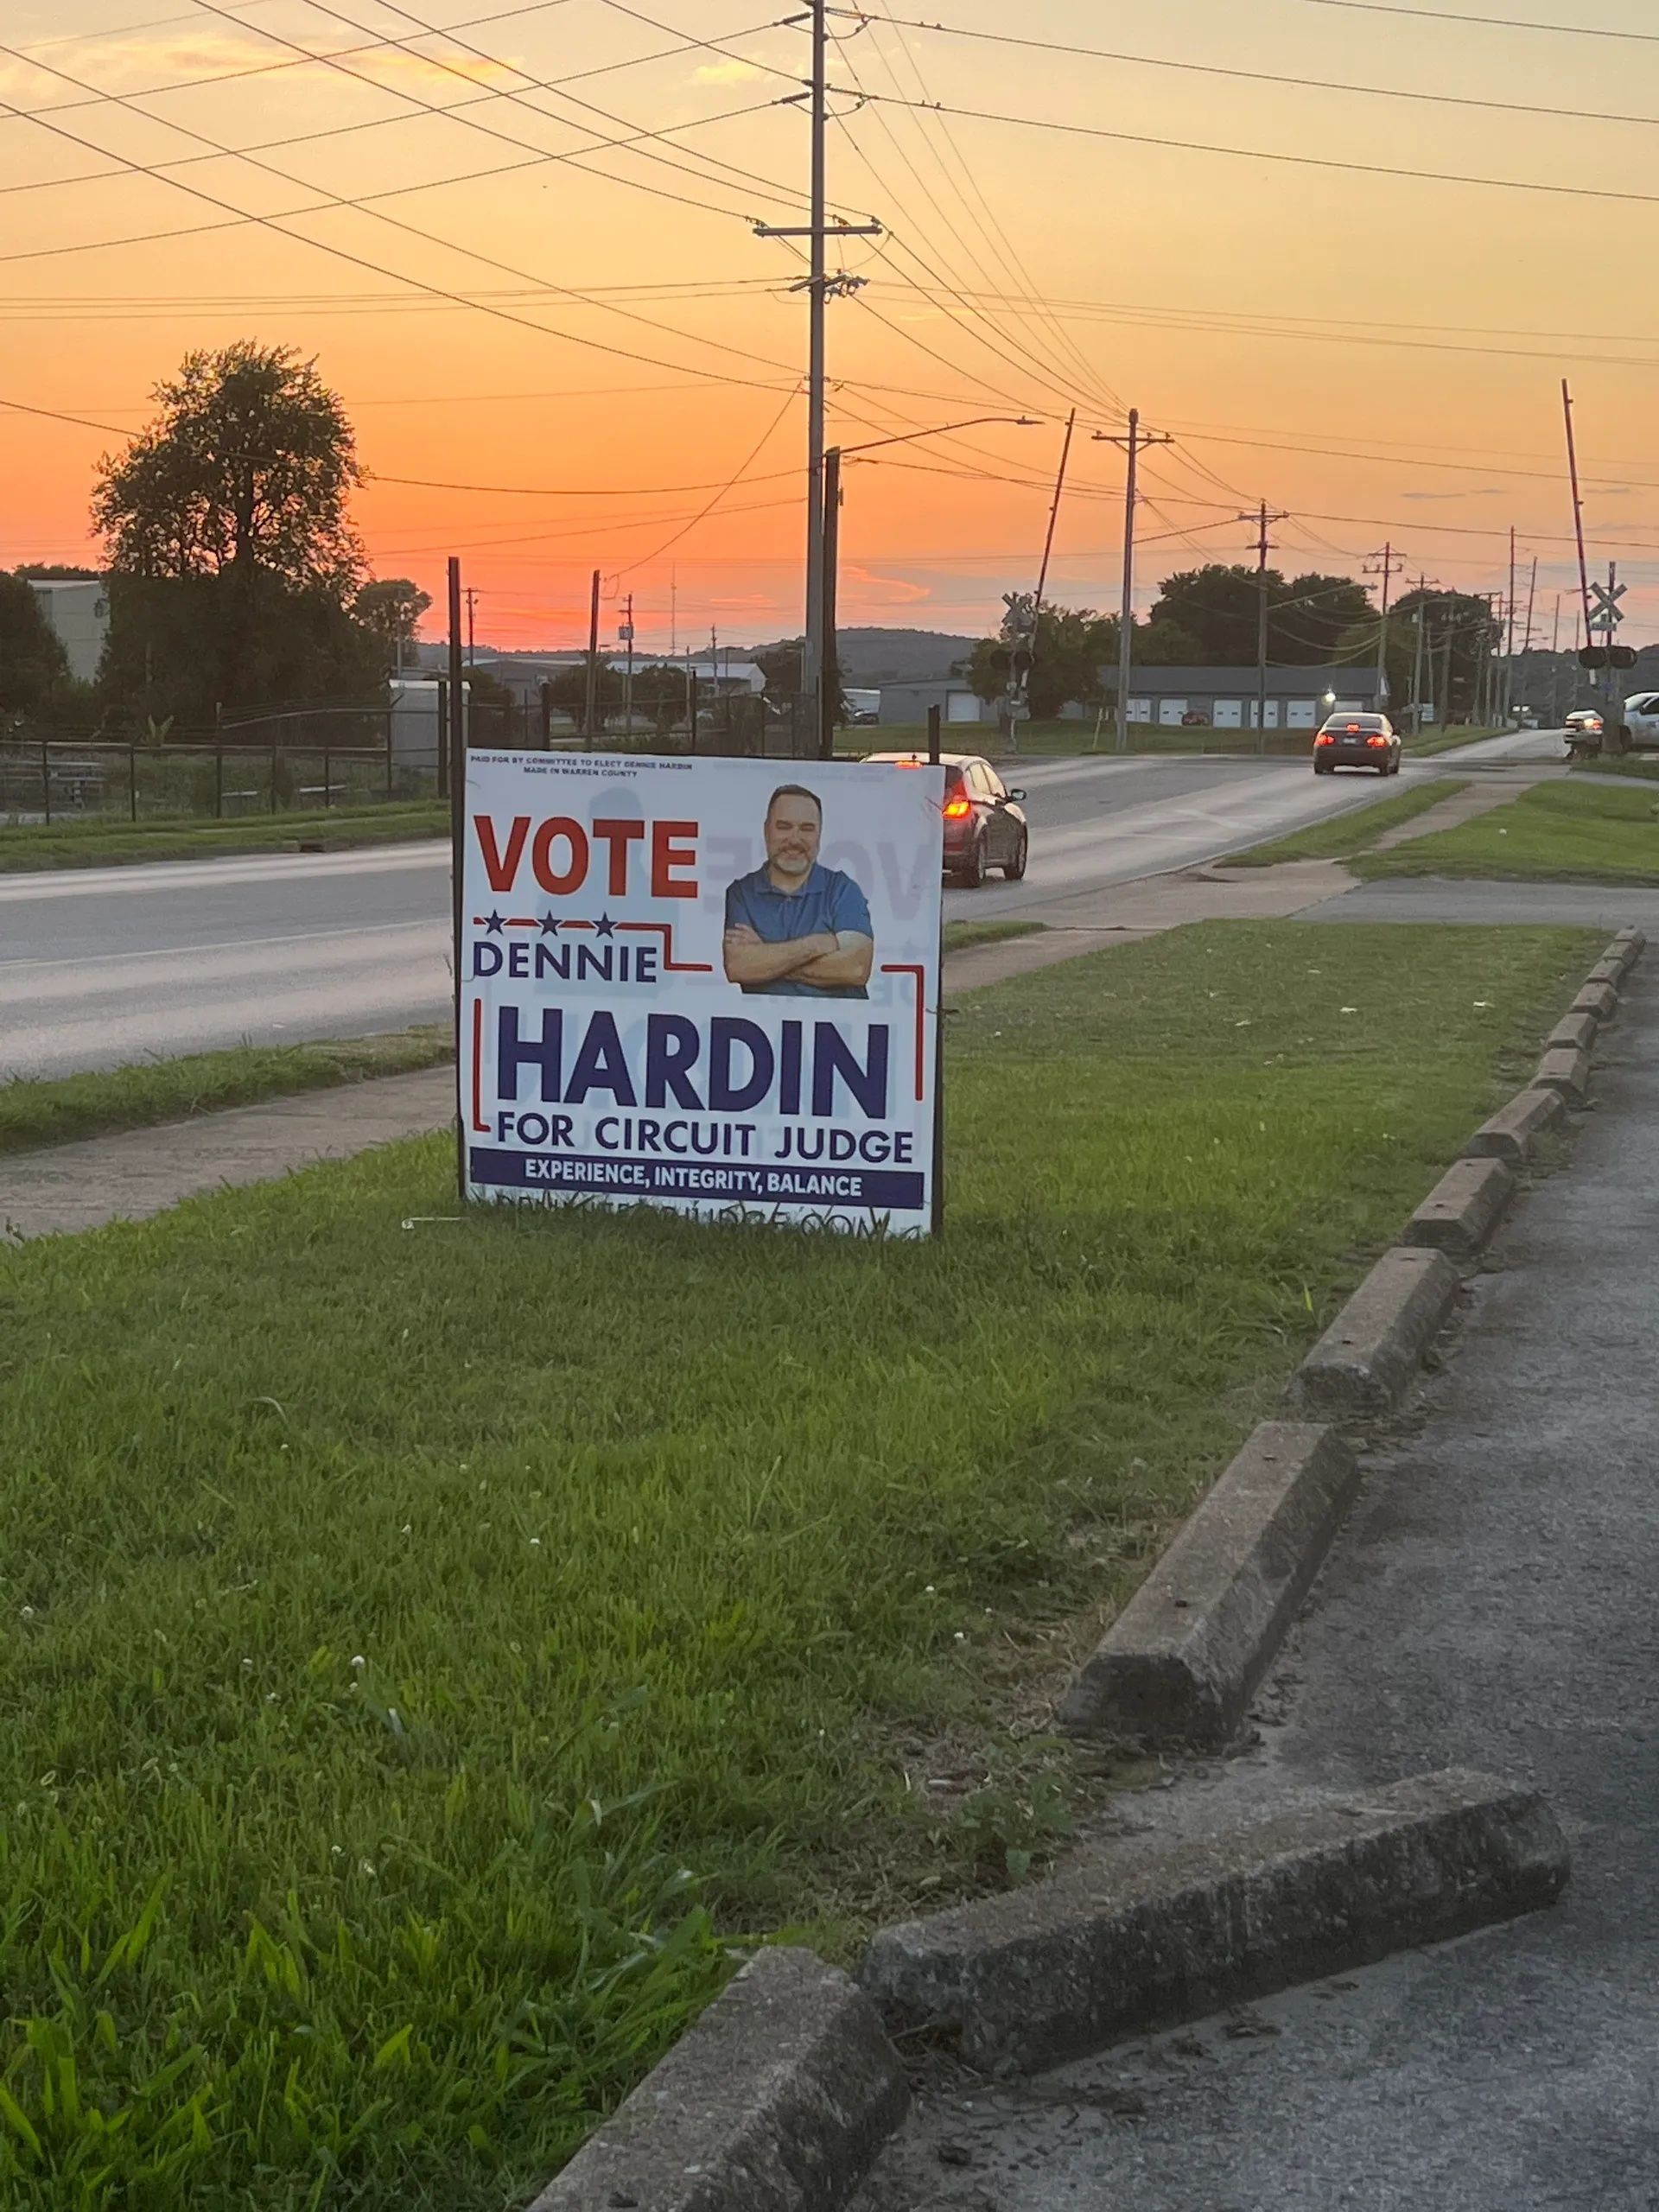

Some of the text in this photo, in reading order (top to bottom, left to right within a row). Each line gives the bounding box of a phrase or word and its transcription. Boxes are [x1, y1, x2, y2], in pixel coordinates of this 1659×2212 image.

[525, 757, 577, 766] COMMITTEE
[580, 759, 592, 767] TO
[594, 759, 622, 768] ELECT
[624, 760, 656, 769] DENNIE
[601, 768, 638, 778] COUNTY
[473, 815, 699, 899] VOTE
[473, 941, 658, 983] DENNIE
[497, 1006, 889, 1120] HARDIN
[497, 1111, 913, 1164] FOR CIRCUIT JUDGE
[524, 1159, 862, 1197] EXPERIENCE, INTEGRITY, BALANCE
